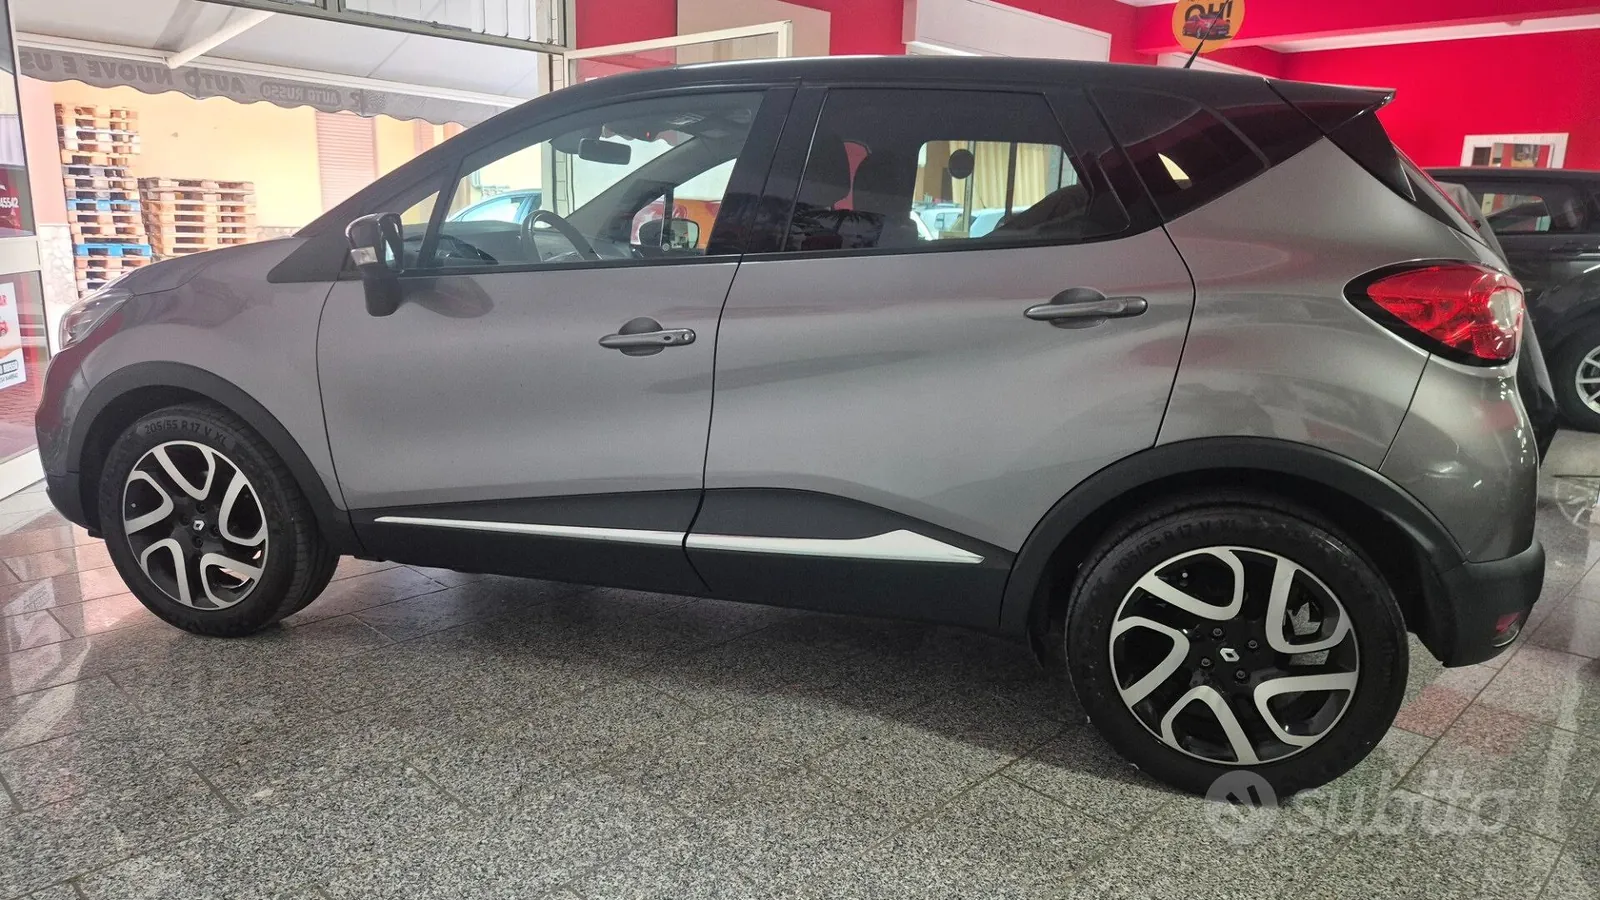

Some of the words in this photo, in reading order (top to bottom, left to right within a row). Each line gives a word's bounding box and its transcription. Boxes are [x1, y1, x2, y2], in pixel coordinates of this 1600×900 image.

[144, 420, 178, 435] 205/55
[181, 420, 188, 429] R
[190, 421, 201, 433] 17
[204, 426, 213, 437] V
